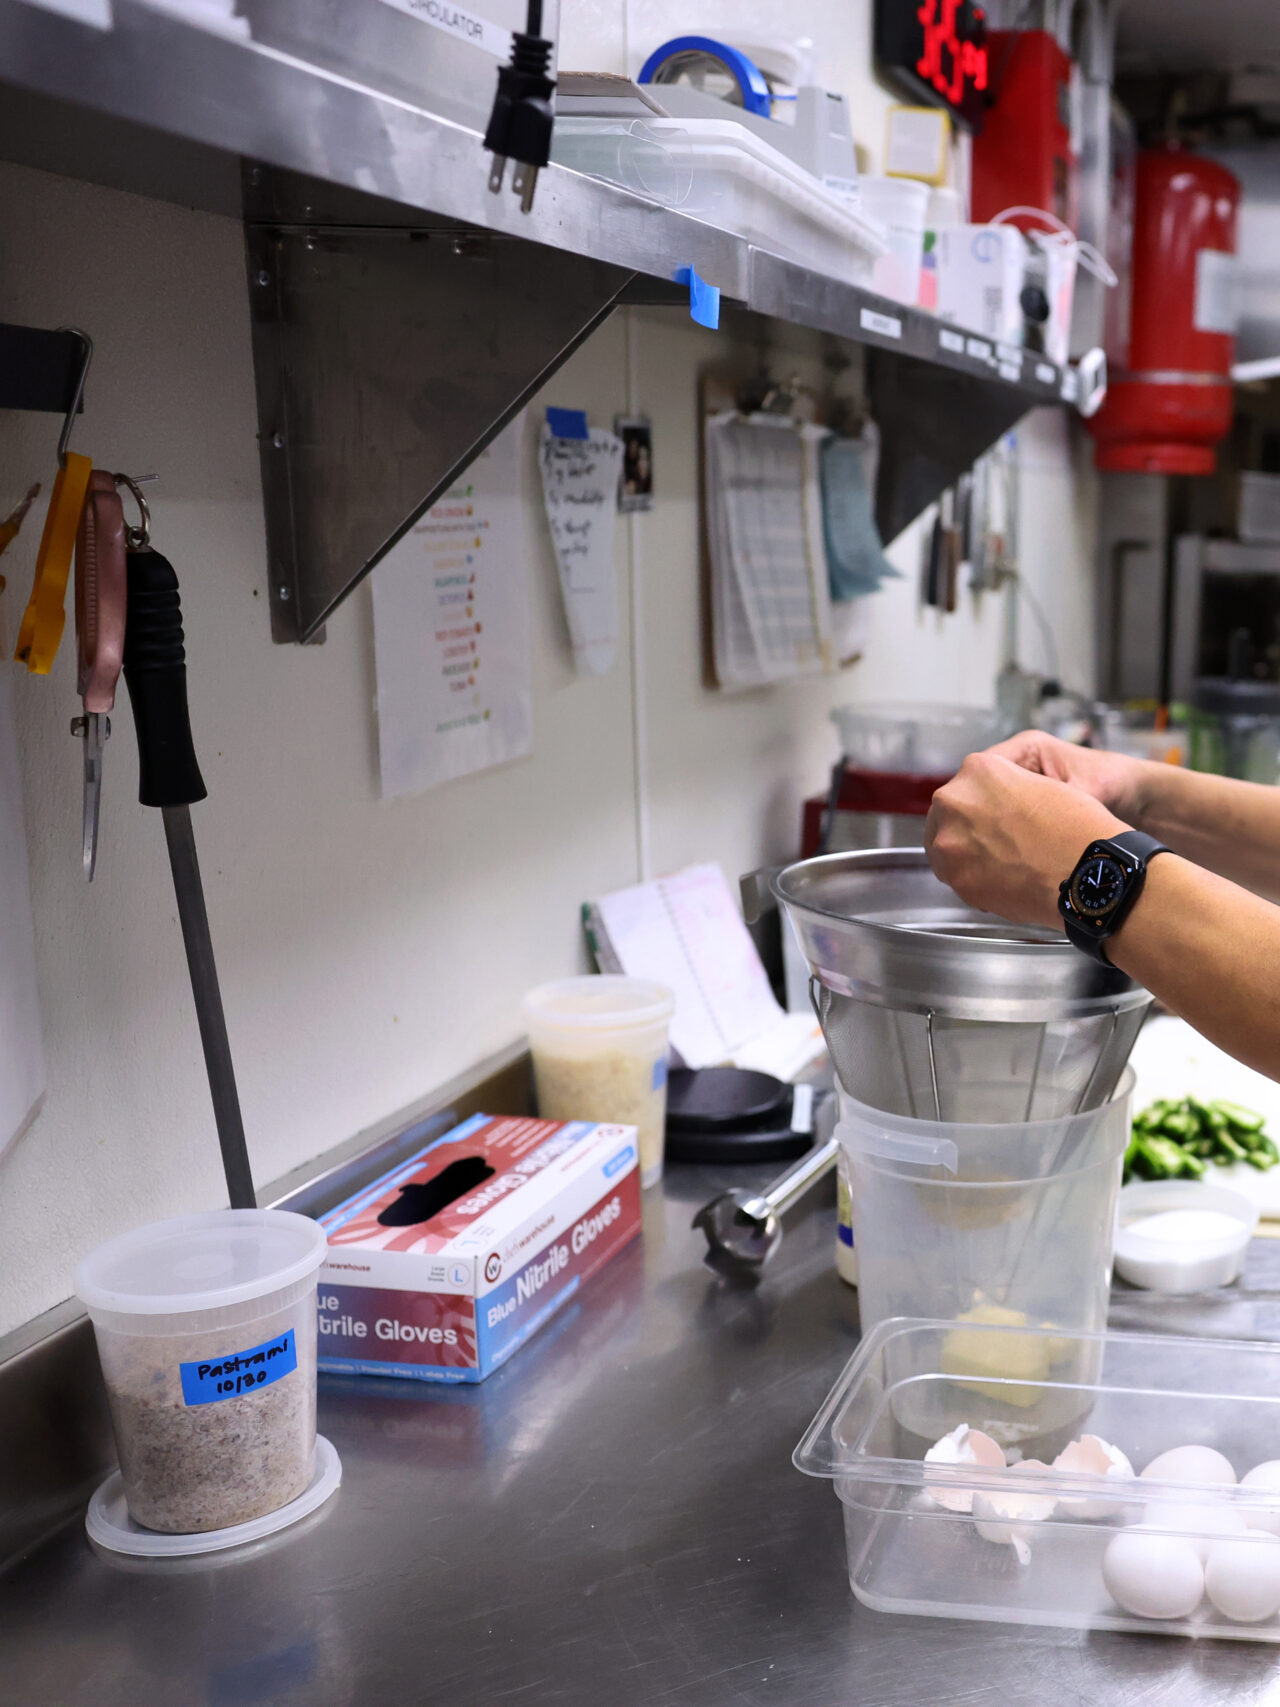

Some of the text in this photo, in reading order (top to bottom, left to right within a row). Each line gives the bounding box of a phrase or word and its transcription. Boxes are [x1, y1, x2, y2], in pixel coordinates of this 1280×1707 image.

[454, 1269, 463, 1283] L
[487, 1296, 517, 1329] Blue
[516, 1244, 570, 1306] Nitrile
[571, 1196, 622, 1256] Gloves
[317, 1295, 340, 1311] ue
[318, 1314, 458, 1345] trile Gloves
[198, 1338, 288, 1380] Pastrami
[217, 1371, 267, 1394] 10/30
